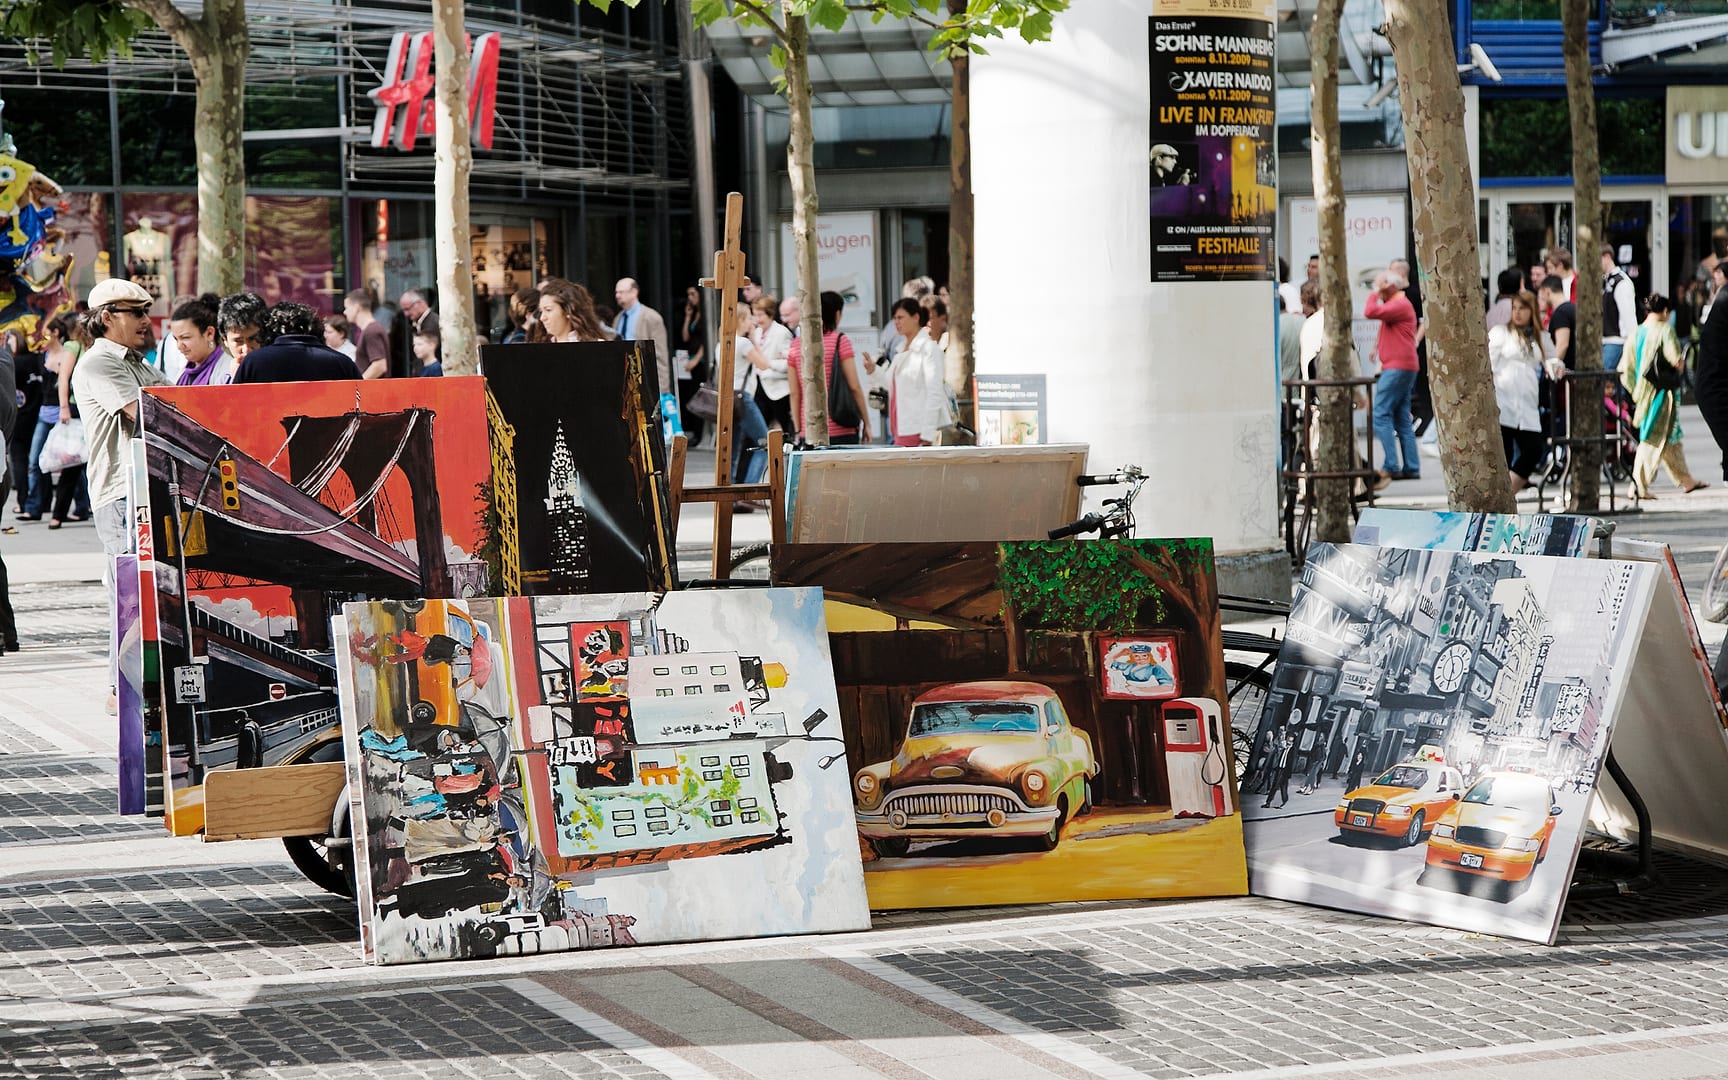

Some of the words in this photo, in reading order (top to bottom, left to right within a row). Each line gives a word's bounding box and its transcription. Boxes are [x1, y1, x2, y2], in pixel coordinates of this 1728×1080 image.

[1155, 21, 1171, 31] Das
[1215, 36, 1274, 56] MANNHEIMS
[1175, 56, 1206, 64] SONNTAG
[1207, 52, 1251, 66] 8.11.2009
[1170, 71, 1234, 92] XAVIER
[1234, 72, 1272, 92] NAIDOO
[1177, 92, 1206, 101] MONTAG
[1207, 88, 1251, 103] 9.11.2009
[1160, 106, 1194, 124] LIVE
[1198, 107, 1216, 124] IN
[1220, 107, 1274, 125] FRANKFURT
[1195, 124, 1209, 137] IM
[1210, 124, 1260, 138] DOPPELPACK
[1197, 237, 1260, 255] FESTHALLE
